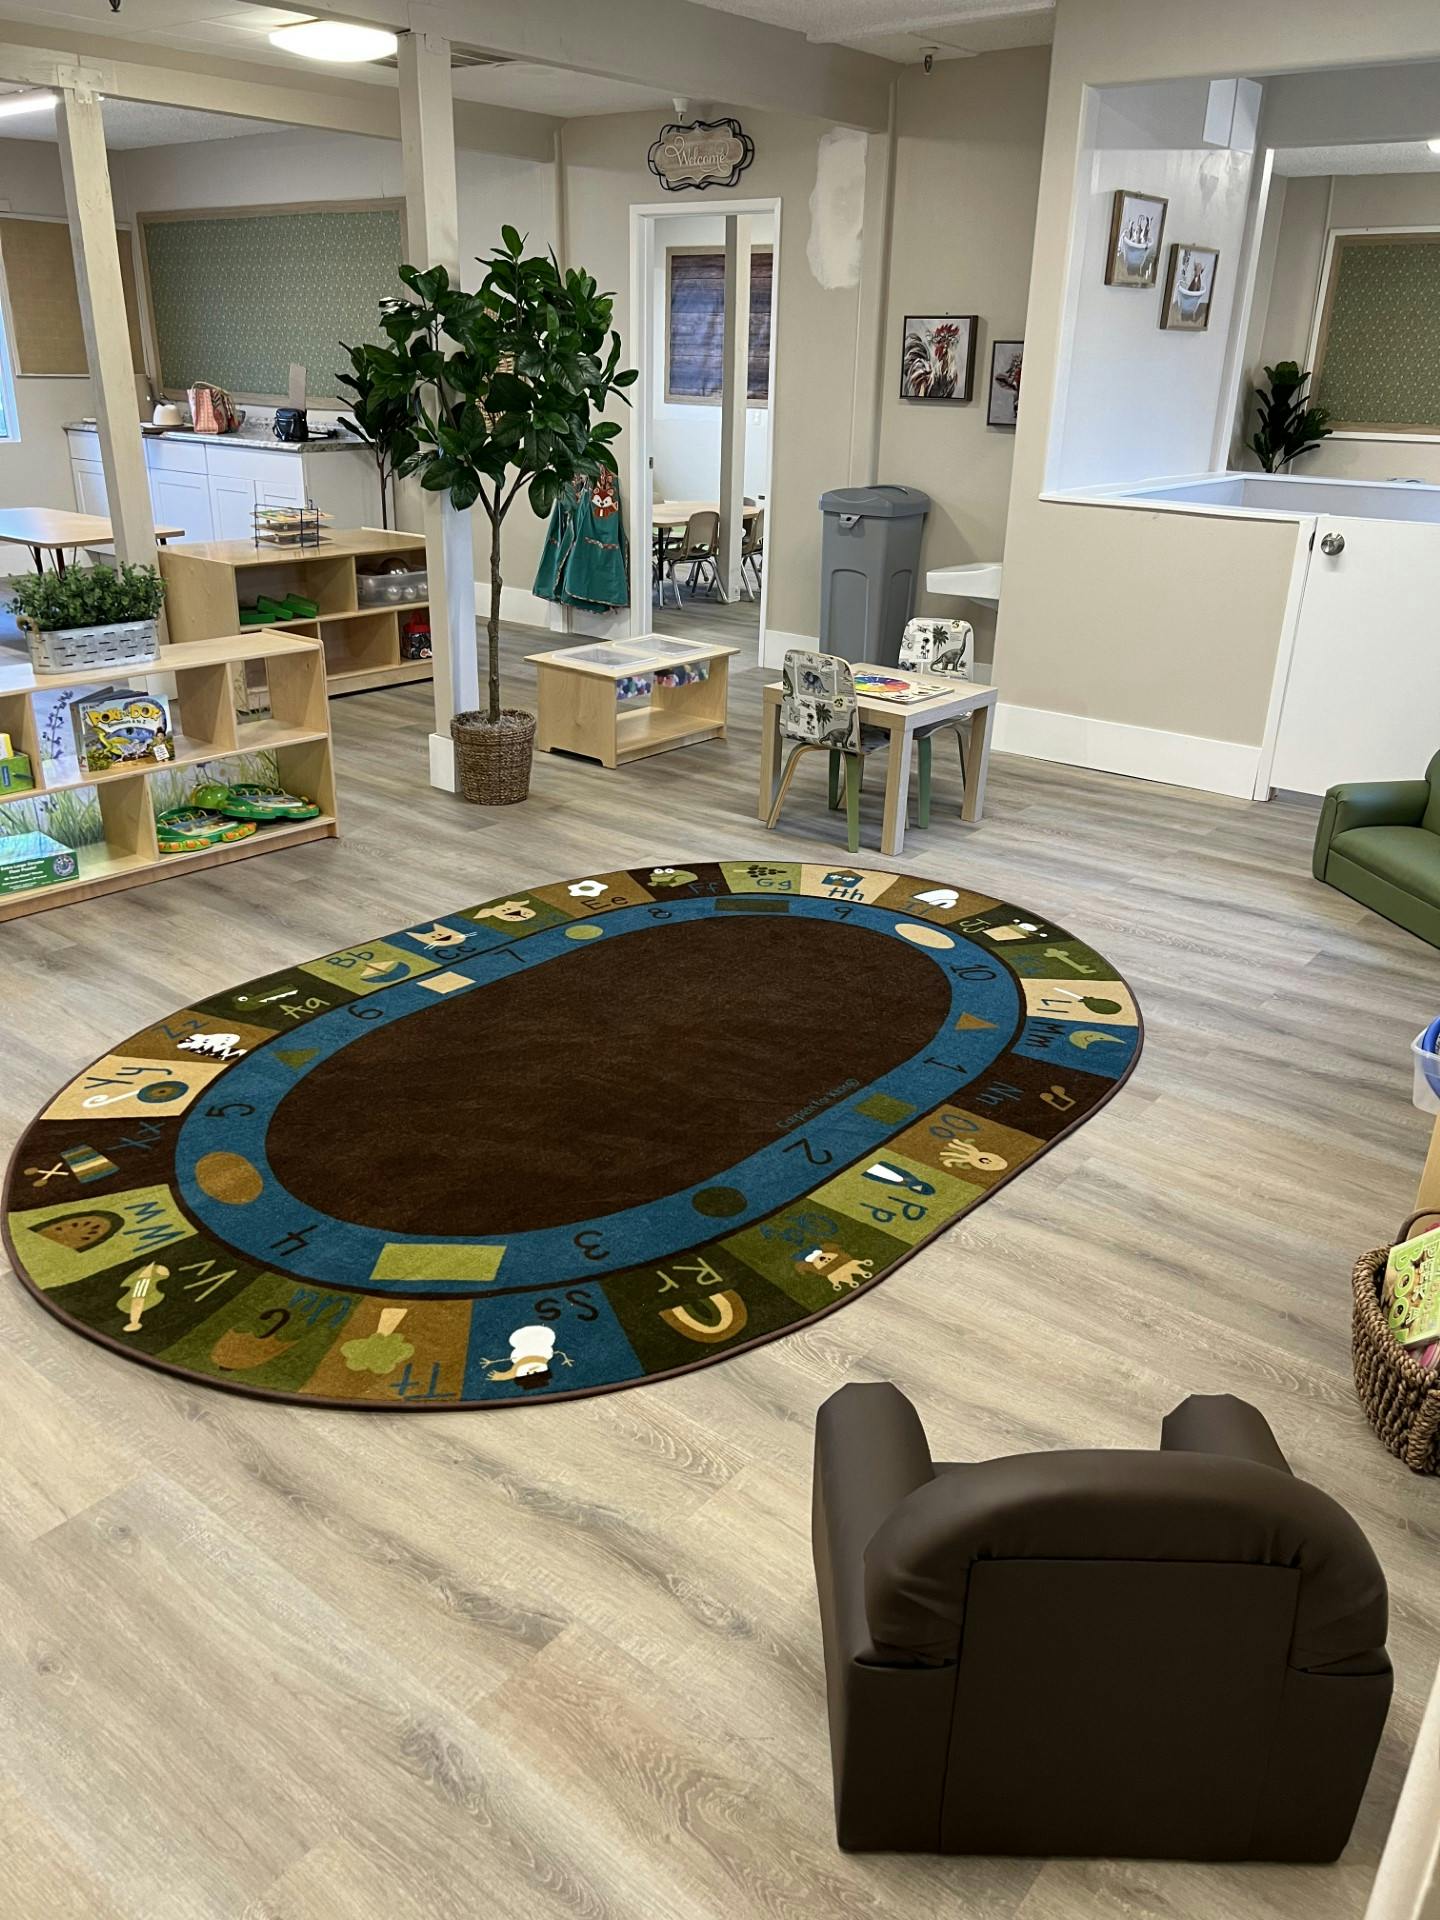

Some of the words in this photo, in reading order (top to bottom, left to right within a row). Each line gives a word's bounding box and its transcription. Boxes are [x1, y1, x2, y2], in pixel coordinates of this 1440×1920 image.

[664, 136, 730, 173] Welcome
[756, 878, 792, 891] Gg
[828, 887, 866, 901] Hh
[581, 895, 629, 911] Ee
[648, 907, 672, 919] 8
[834, 906, 854, 919] 9
[959, 919, 991, 934] Jj
[326, 949, 375, 969] Bb
[434, 945, 477, 960] Cc
[494, 948, 527, 963] 7
[951, 964, 997, 983] 10
[279, 996, 331, 1021] Aa
[347, 1003, 385, 1021] 6
[155, 1018, 210, 1040] Zz
[923, 1056, 969, 1076] 1
[84, 1066, 173, 1089] Yy
[205, 1103, 257, 1118] 5
[104, 1121, 166, 1150] Xx
[929, 1113, 982, 1139] Oo
[782, 1137, 834, 1166] 2
[859, 1195, 930, 1223] Pp
[122, 1200, 187, 1253] Ww
[269, 1225, 319, 1257] 4
[573, 1230, 611, 1262] 3
[178, 1258, 239, 1303] Vv
[655, 1256, 724, 1294] Rr
[533, 1290, 599, 1321] Ss
[388, 1361, 458, 1400] Tt
